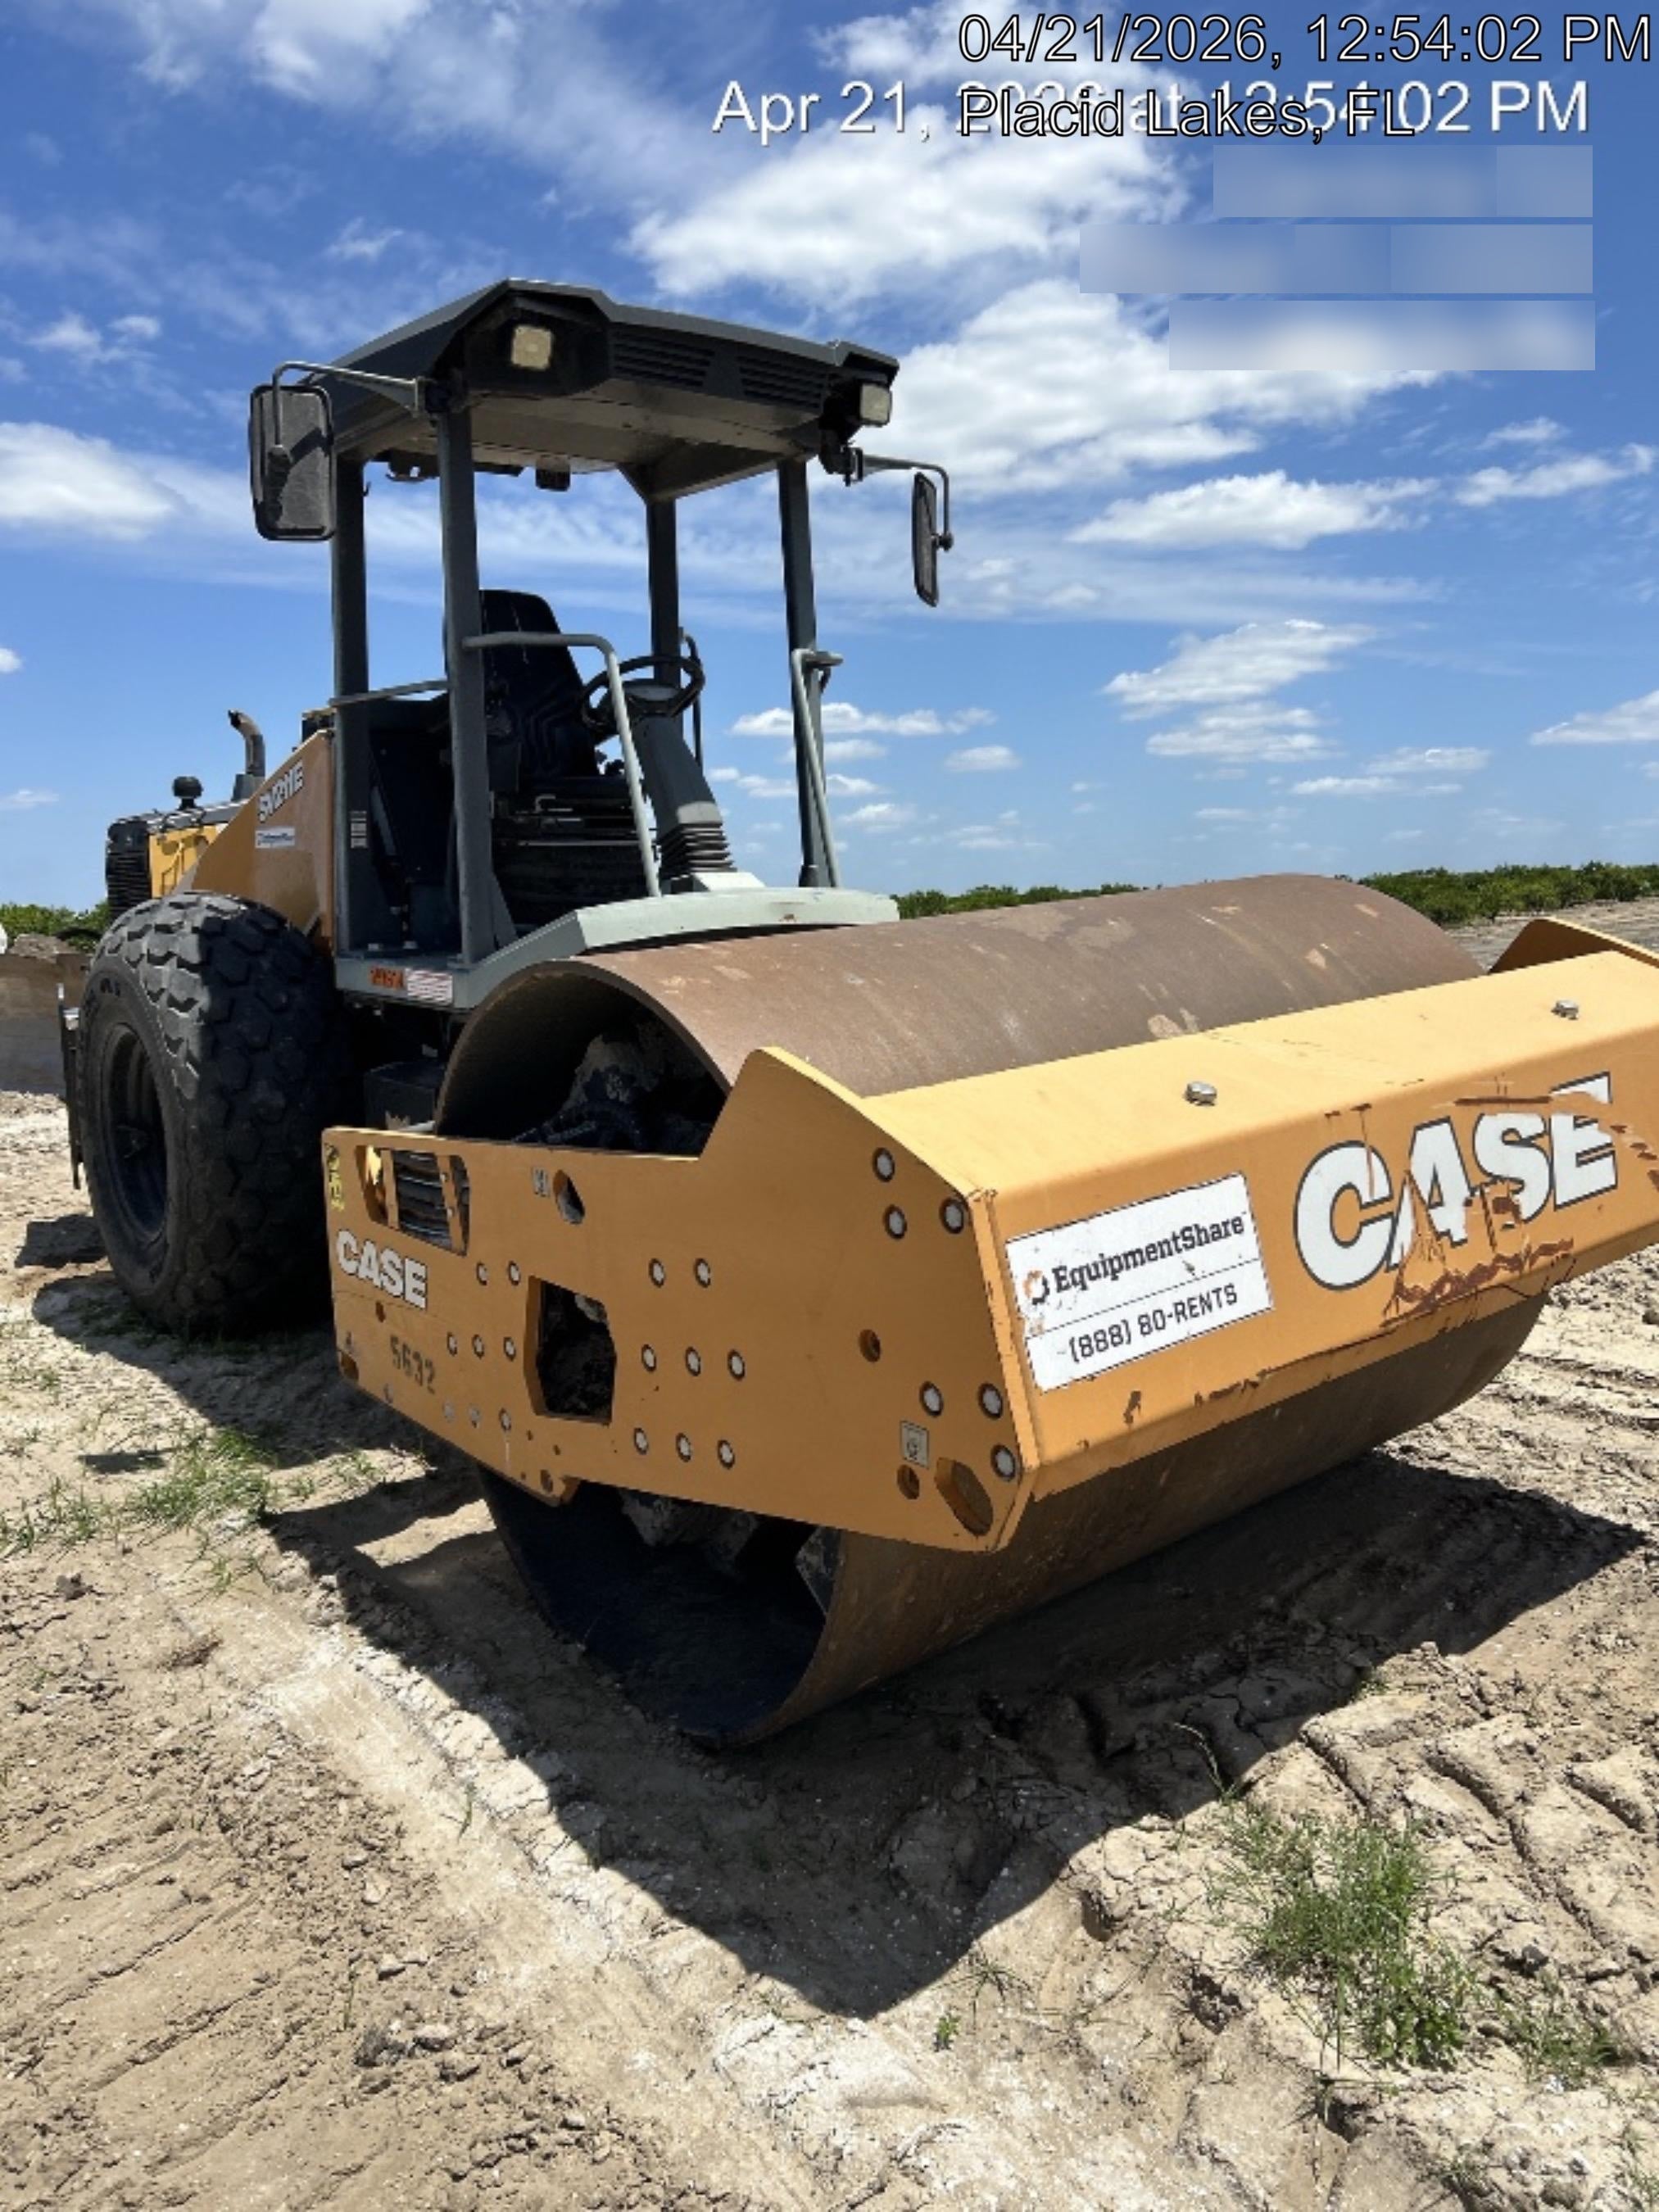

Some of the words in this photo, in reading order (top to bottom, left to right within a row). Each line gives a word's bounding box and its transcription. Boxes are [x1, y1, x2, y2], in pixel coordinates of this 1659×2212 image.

[1293, 1071, 1618, 1291] CASE
[335, 1229, 428, 1312] CASE
[1051, 1215, 1244, 1294] EquipmentShare
[1068, 1319, 1132, 1363] (888)
[1136, 1282, 1239, 1336] 80-RENTS
